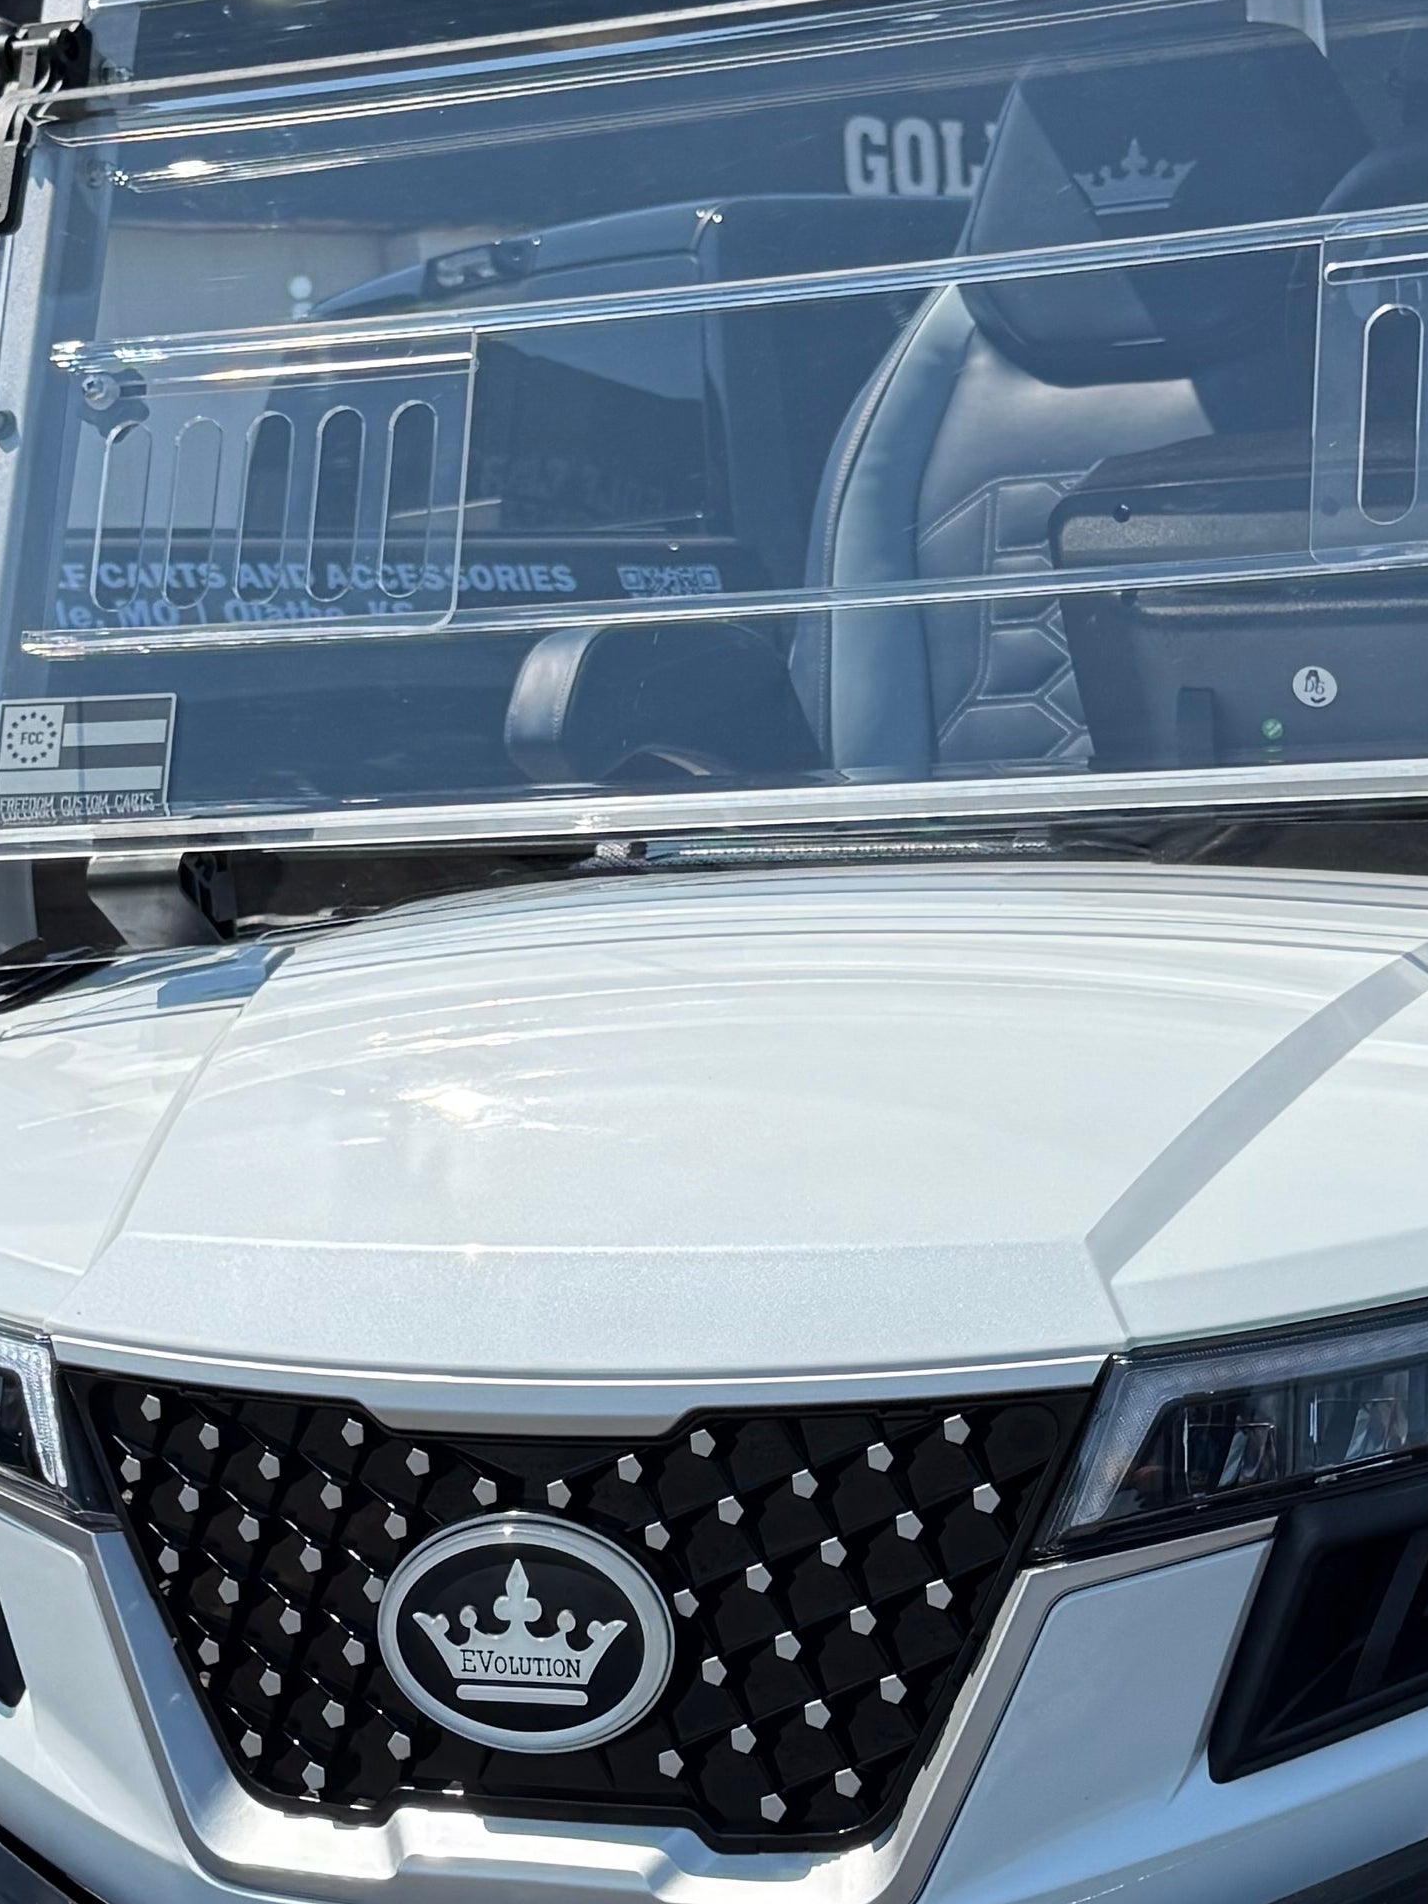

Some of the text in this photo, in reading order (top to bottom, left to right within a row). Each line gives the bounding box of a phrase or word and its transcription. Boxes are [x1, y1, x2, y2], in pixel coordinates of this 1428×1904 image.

[844, 116, 999, 196] GOL
[98, 562, 226, 590] CARTS
[238, 562, 314, 590] AND
[326, 562, 577, 593] ACCESSORIES
[20, 731, 44, 746] FCC
[0, 792, 155, 815] FREEDOM CUSTOM CARTS
